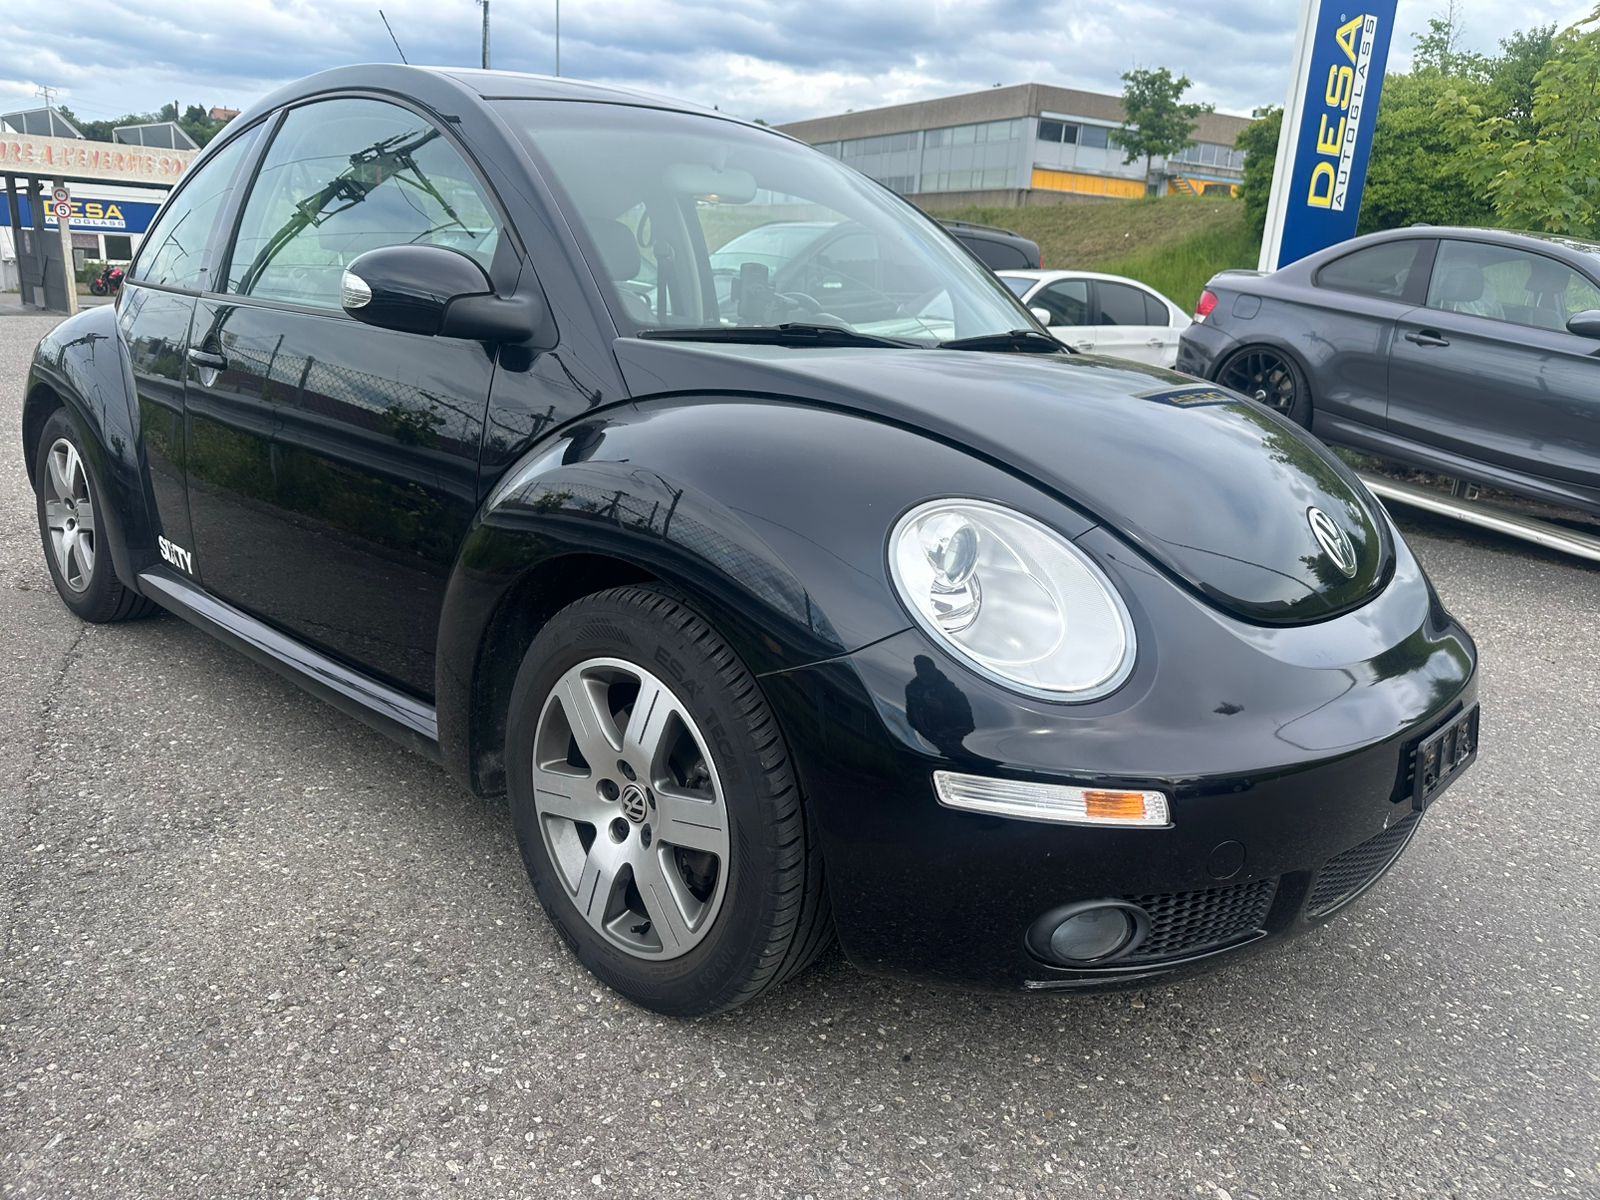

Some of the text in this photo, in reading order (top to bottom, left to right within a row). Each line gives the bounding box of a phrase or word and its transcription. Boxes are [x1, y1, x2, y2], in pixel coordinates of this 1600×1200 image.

[1307, 14, 1364, 209] DESA
[1336, 18, 1374, 207] AUTOGLASS
[47, 217, 124, 226] AOGLASS
[59, 205, 67, 215] 5
